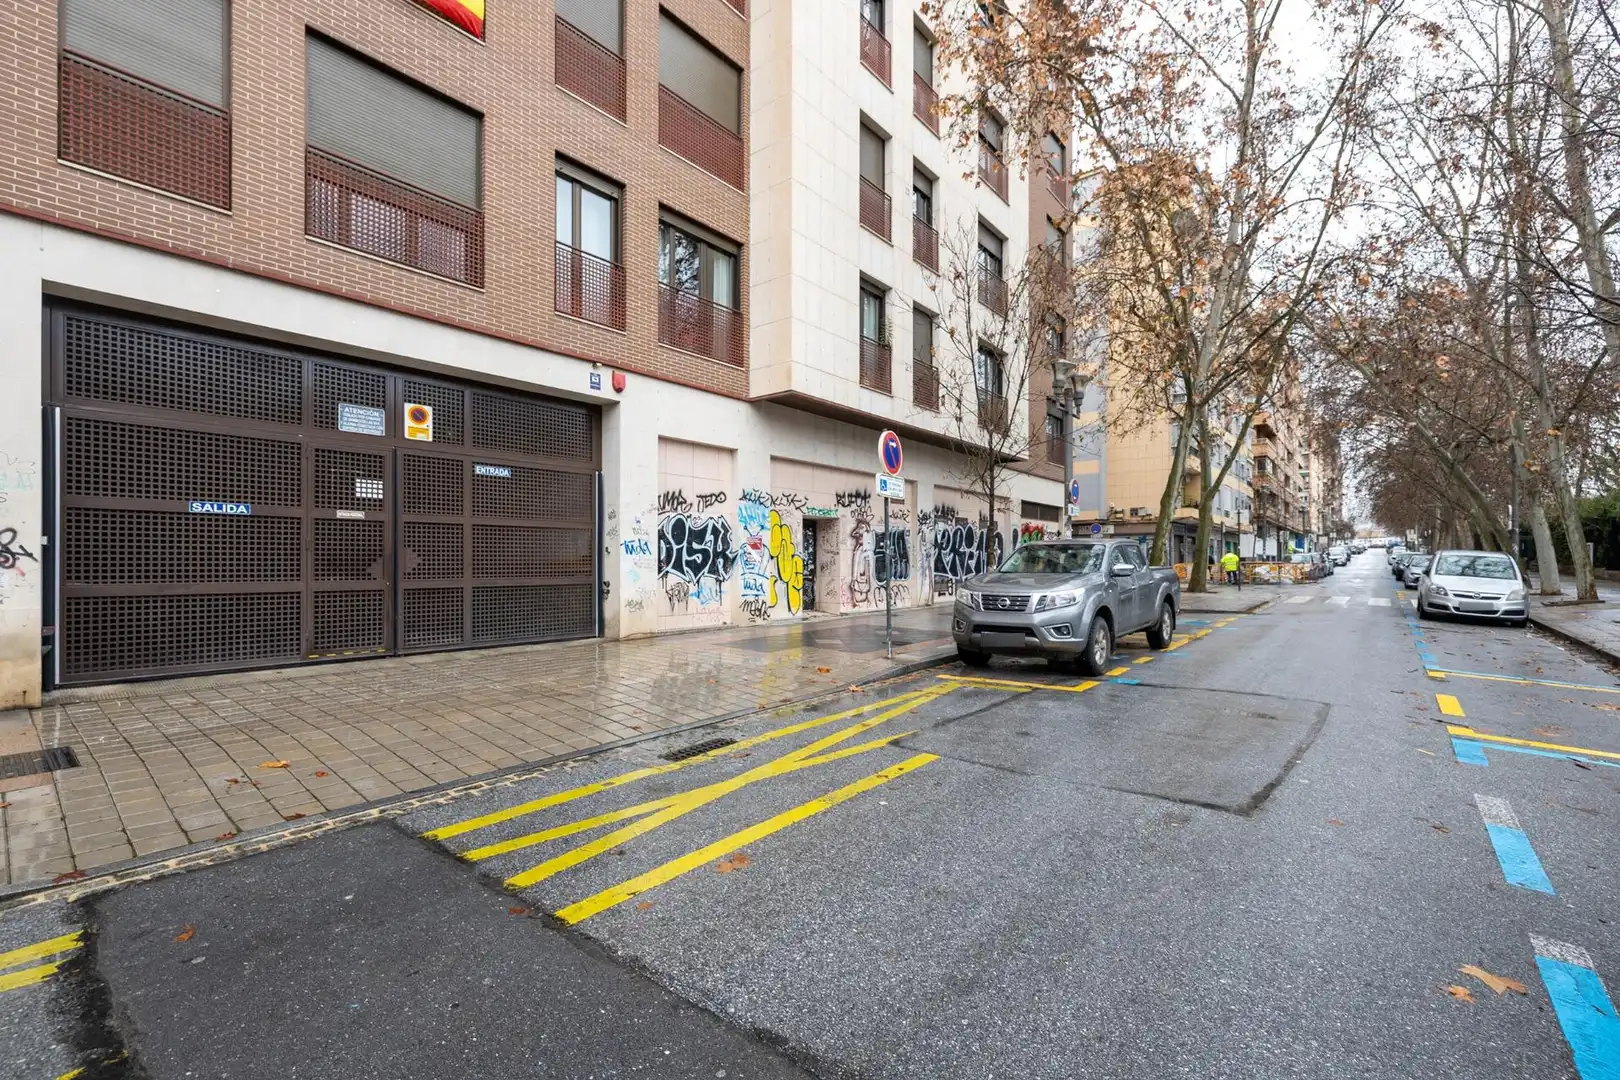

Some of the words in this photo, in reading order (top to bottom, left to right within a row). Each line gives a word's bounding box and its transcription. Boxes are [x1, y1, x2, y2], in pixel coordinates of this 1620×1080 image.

[343, 405, 380, 418] ATENCIÓN
[475, 465, 511, 477] ENTRADA
[191, 502, 249, 514] SALIDA
